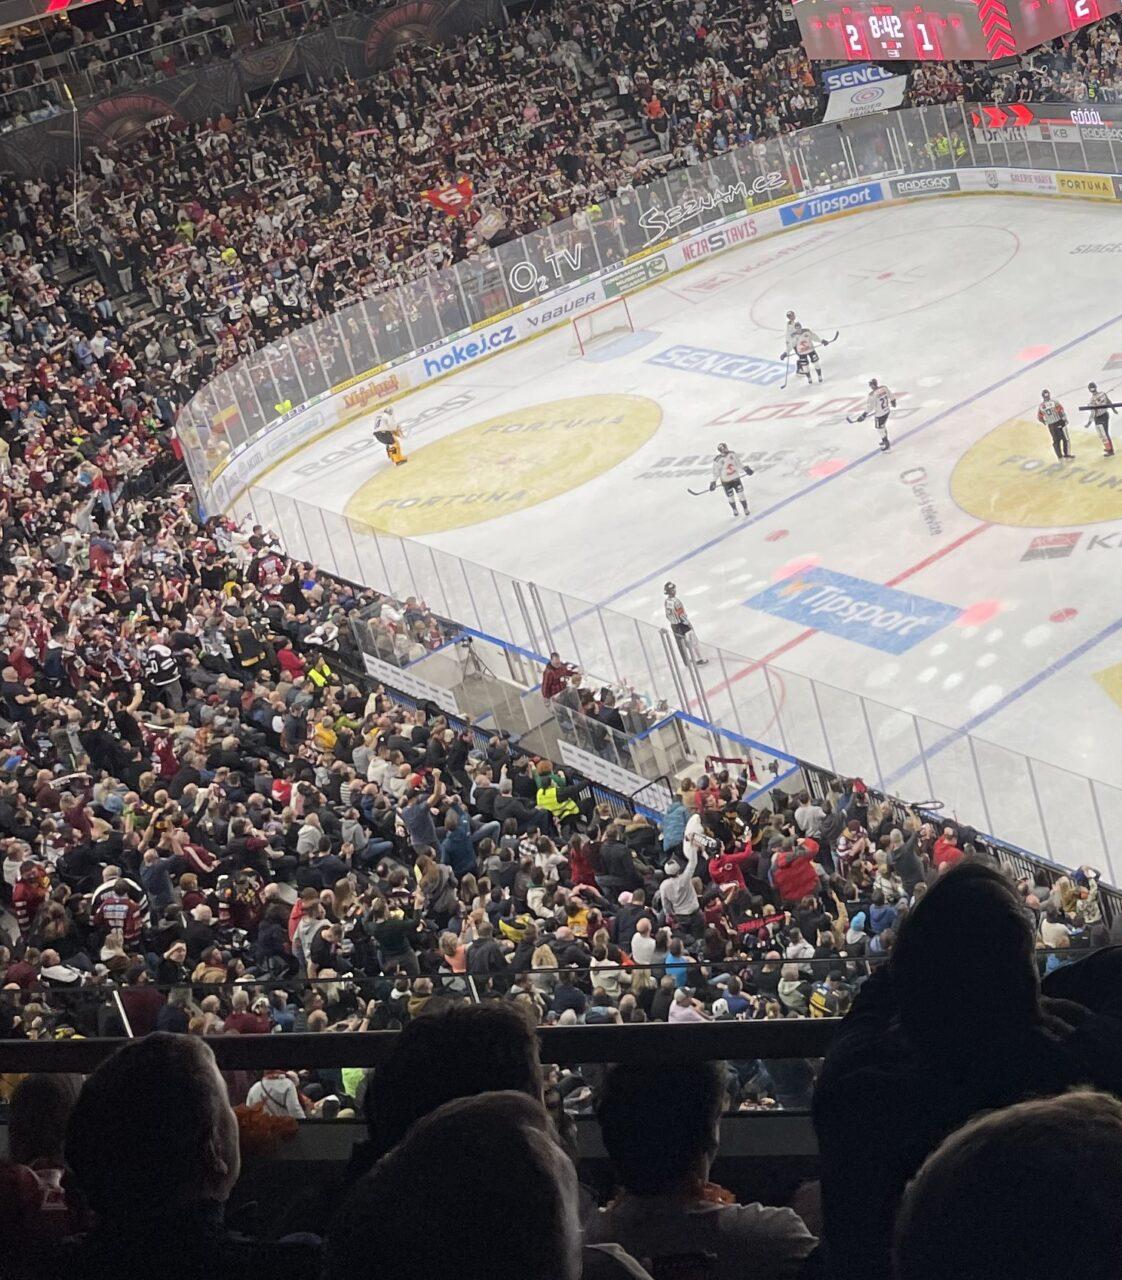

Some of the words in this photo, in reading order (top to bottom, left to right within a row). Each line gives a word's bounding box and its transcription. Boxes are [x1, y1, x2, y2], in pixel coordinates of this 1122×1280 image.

[846, 23, 862, 51] 2
[868, 15, 904, 39] 8:42
[917, 23, 933, 51] 1
[827, 67, 893, 91] SENCO
[1070, 107, 1104, 126] GÓÓÓL
[1053, 128, 1068, 138] KB
[897, 174, 952, 193] RADEGAST
[1060, 179, 1109, 192] FORTUNA
[438, 188, 464, 205] S
[807, 186, 873, 218] Tipsport
[545, 244, 583, 279] TV
[424, 326, 518, 377] hokej.cz
[653, 348, 786, 386] SENCOR
[483, 413, 624, 437] FORTUNA
[376, 488, 530, 512] FORTUNA
[804, 584, 936, 637] Tipsport
